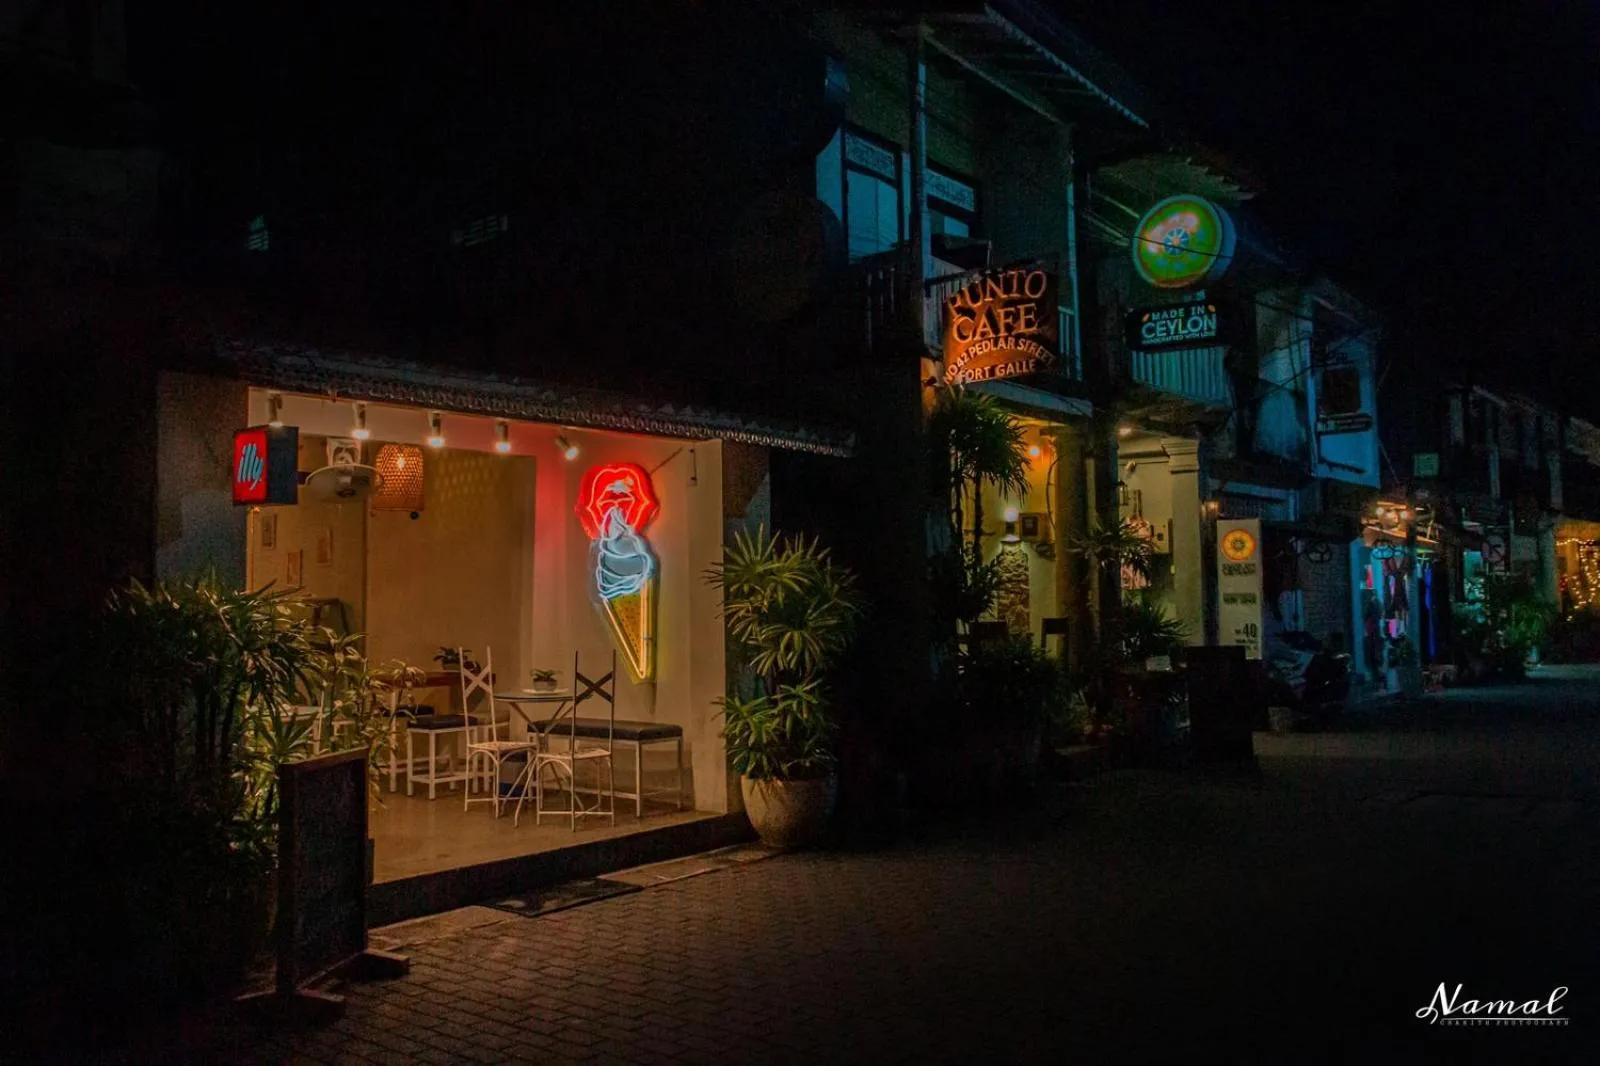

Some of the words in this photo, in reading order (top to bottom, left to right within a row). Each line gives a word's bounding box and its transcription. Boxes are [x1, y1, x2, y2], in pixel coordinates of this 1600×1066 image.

[952, 303, 1041, 343] CAFE
[1141, 313, 1217, 339] CEYLON
[1152, 308, 1185, 321] MADE
[1191, 305, 1206, 316] IN
[969, 336, 1016, 359] PEDLAR
[1017, 338, 1057, 366] STREET
[959, 366, 991, 381] FORT
[995, 359, 1037, 377] GALLE
[237, 443, 264, 491] illy
